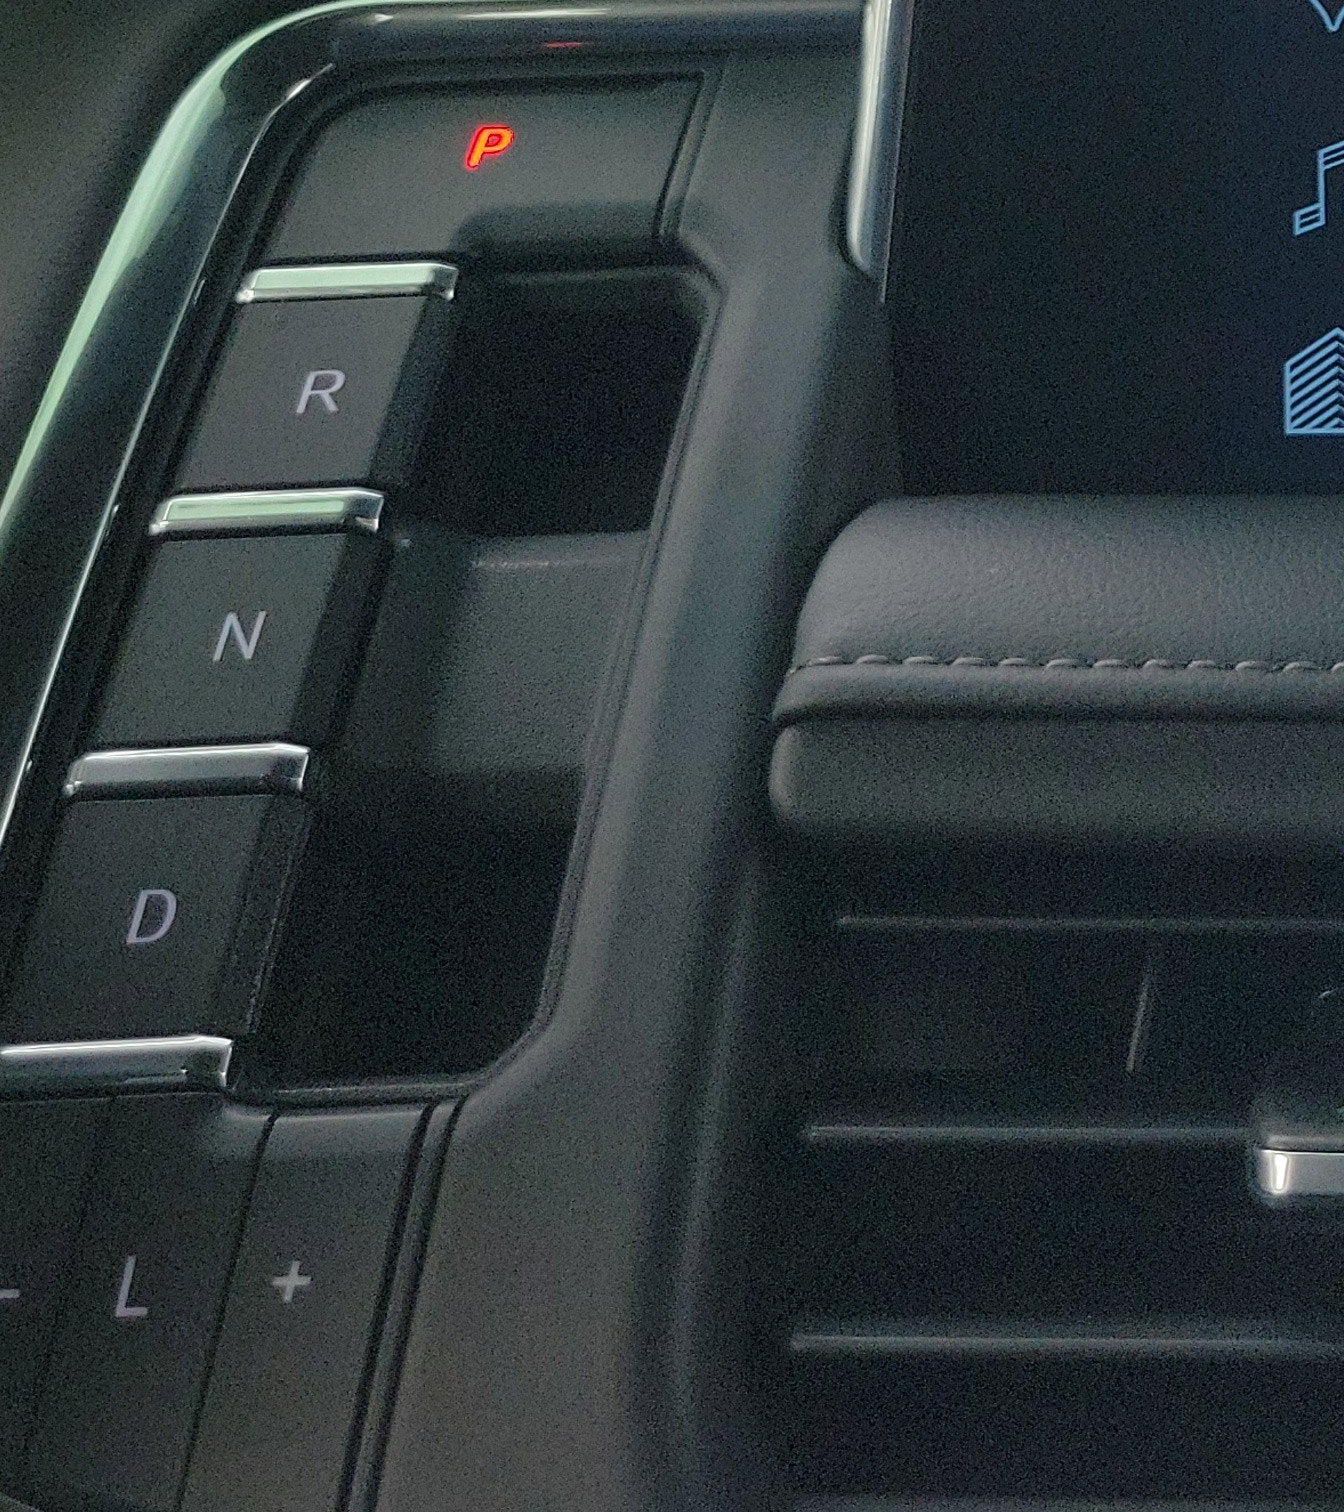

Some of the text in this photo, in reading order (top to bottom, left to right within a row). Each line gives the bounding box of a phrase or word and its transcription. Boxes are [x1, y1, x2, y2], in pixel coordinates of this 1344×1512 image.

[464, 124, 515, 171] P
[295, 369, 346, 415] R
[212, 611, 266, 662] N
[126, 888, 177, 945] D
[114, 1256, 148, 1318] L
